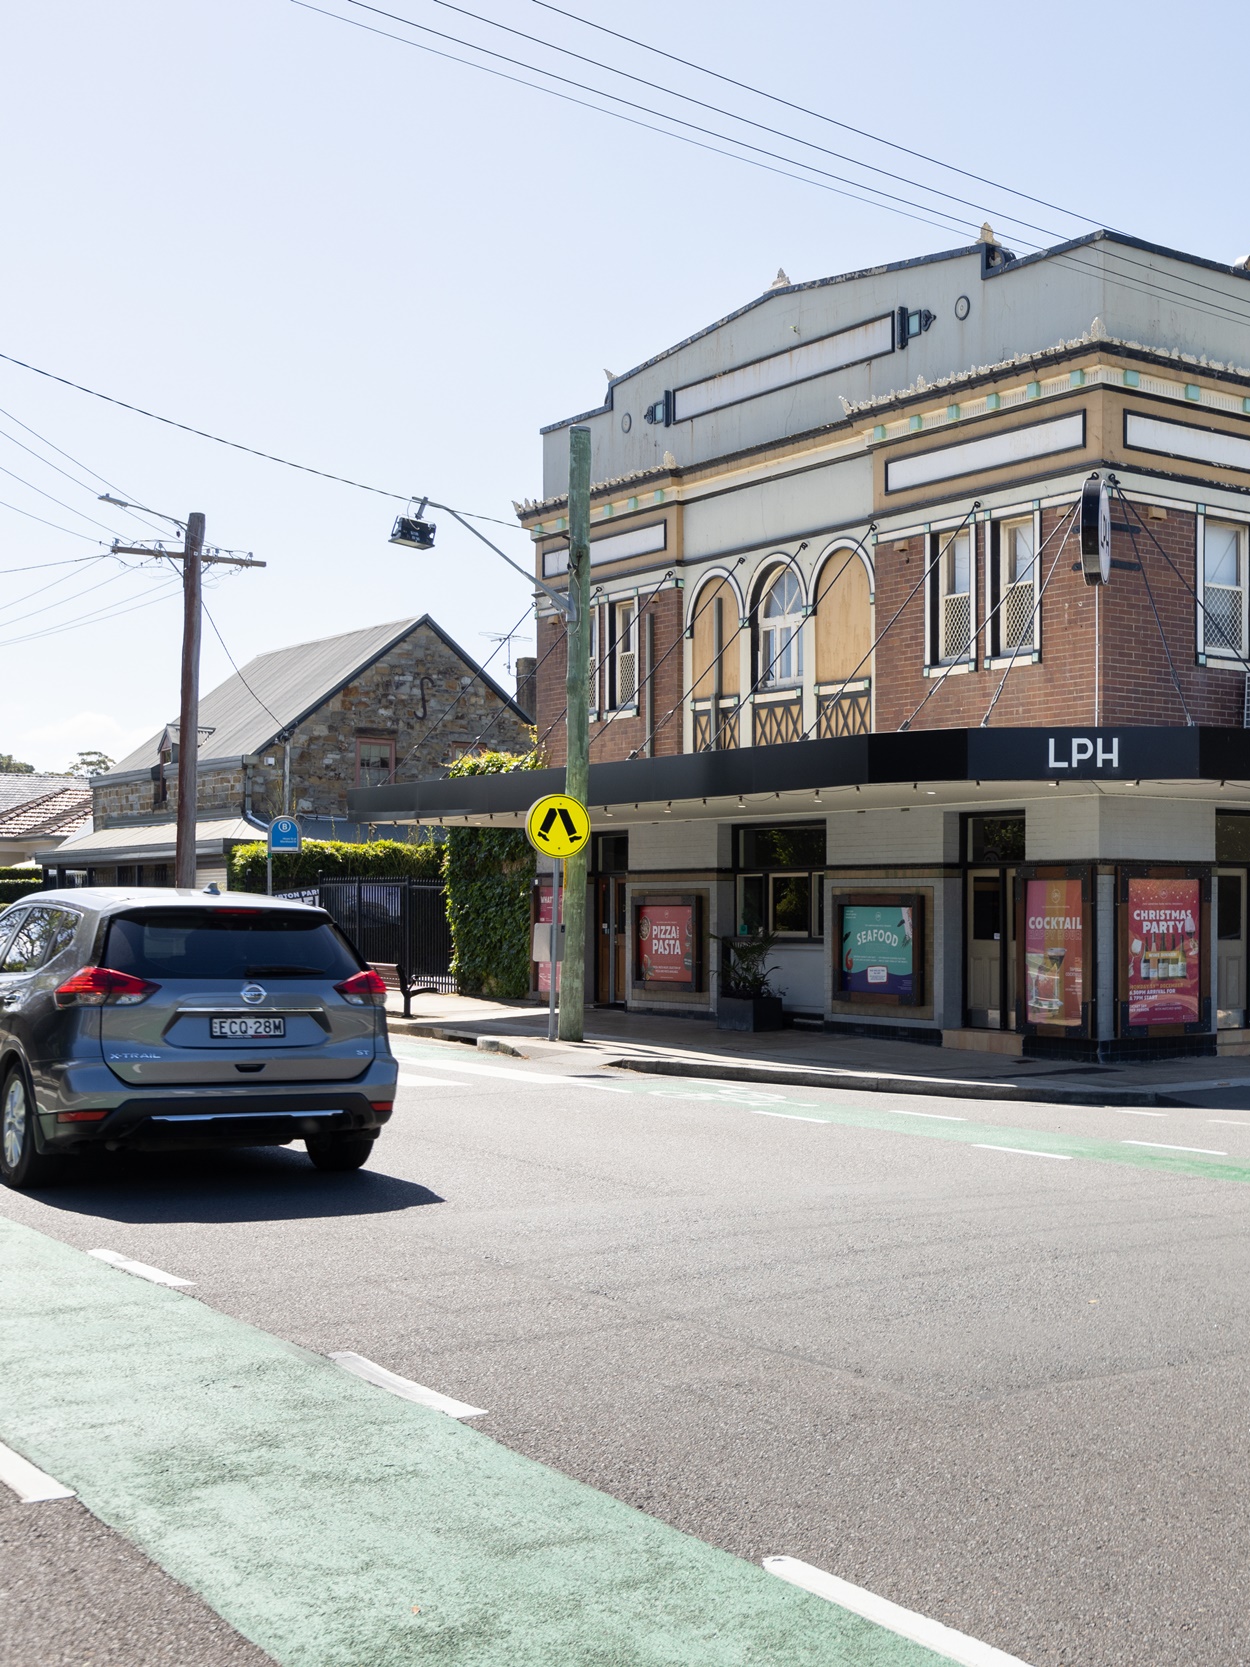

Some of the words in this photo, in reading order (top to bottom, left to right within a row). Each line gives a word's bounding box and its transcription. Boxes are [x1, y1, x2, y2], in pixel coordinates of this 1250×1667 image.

[1048, 737, 1119, 768] LPH
[1133, 909, 1192, 920] CHRISTMAS
[1028, 916, 1082, 929] COCKTAIL
[1142, 921, 1184, 933] PARTY
[652, 925, 677, 938] PIZZA
[856, 929, 898, 947] SEAFOOD
[1057, 930, 1081, 940] HOUR
[652, 939, 681, 955] PASTA
